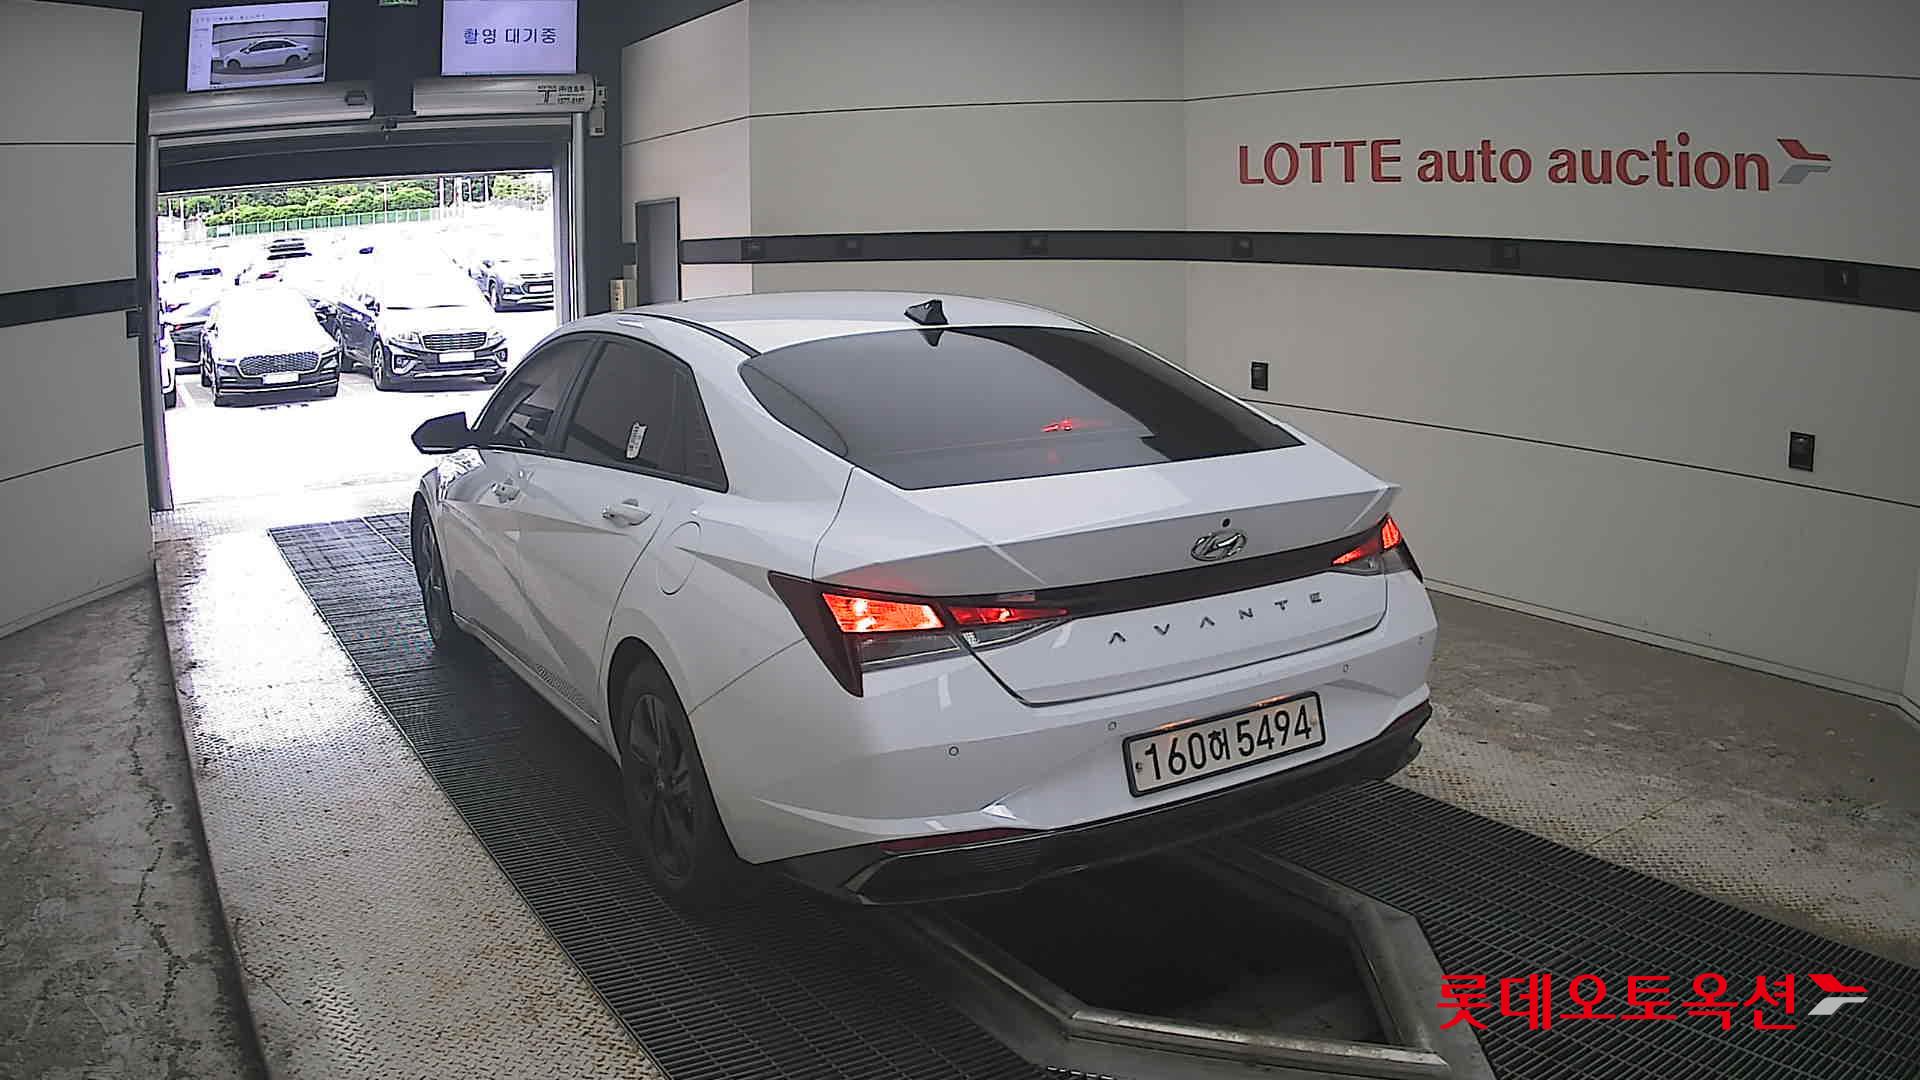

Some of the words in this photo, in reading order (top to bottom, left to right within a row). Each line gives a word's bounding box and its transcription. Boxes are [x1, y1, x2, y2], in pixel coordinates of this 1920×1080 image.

[464, 28, 497, 45] 촬영
[505, 28, 556, 44] 대기중
[1239, 139, 1402, 185] LOTTE
[1417, 139, 1533, 184] auto
[1548, 131, 1770, 191] auction
[1109, 591, 1323, 644] AVANTE
